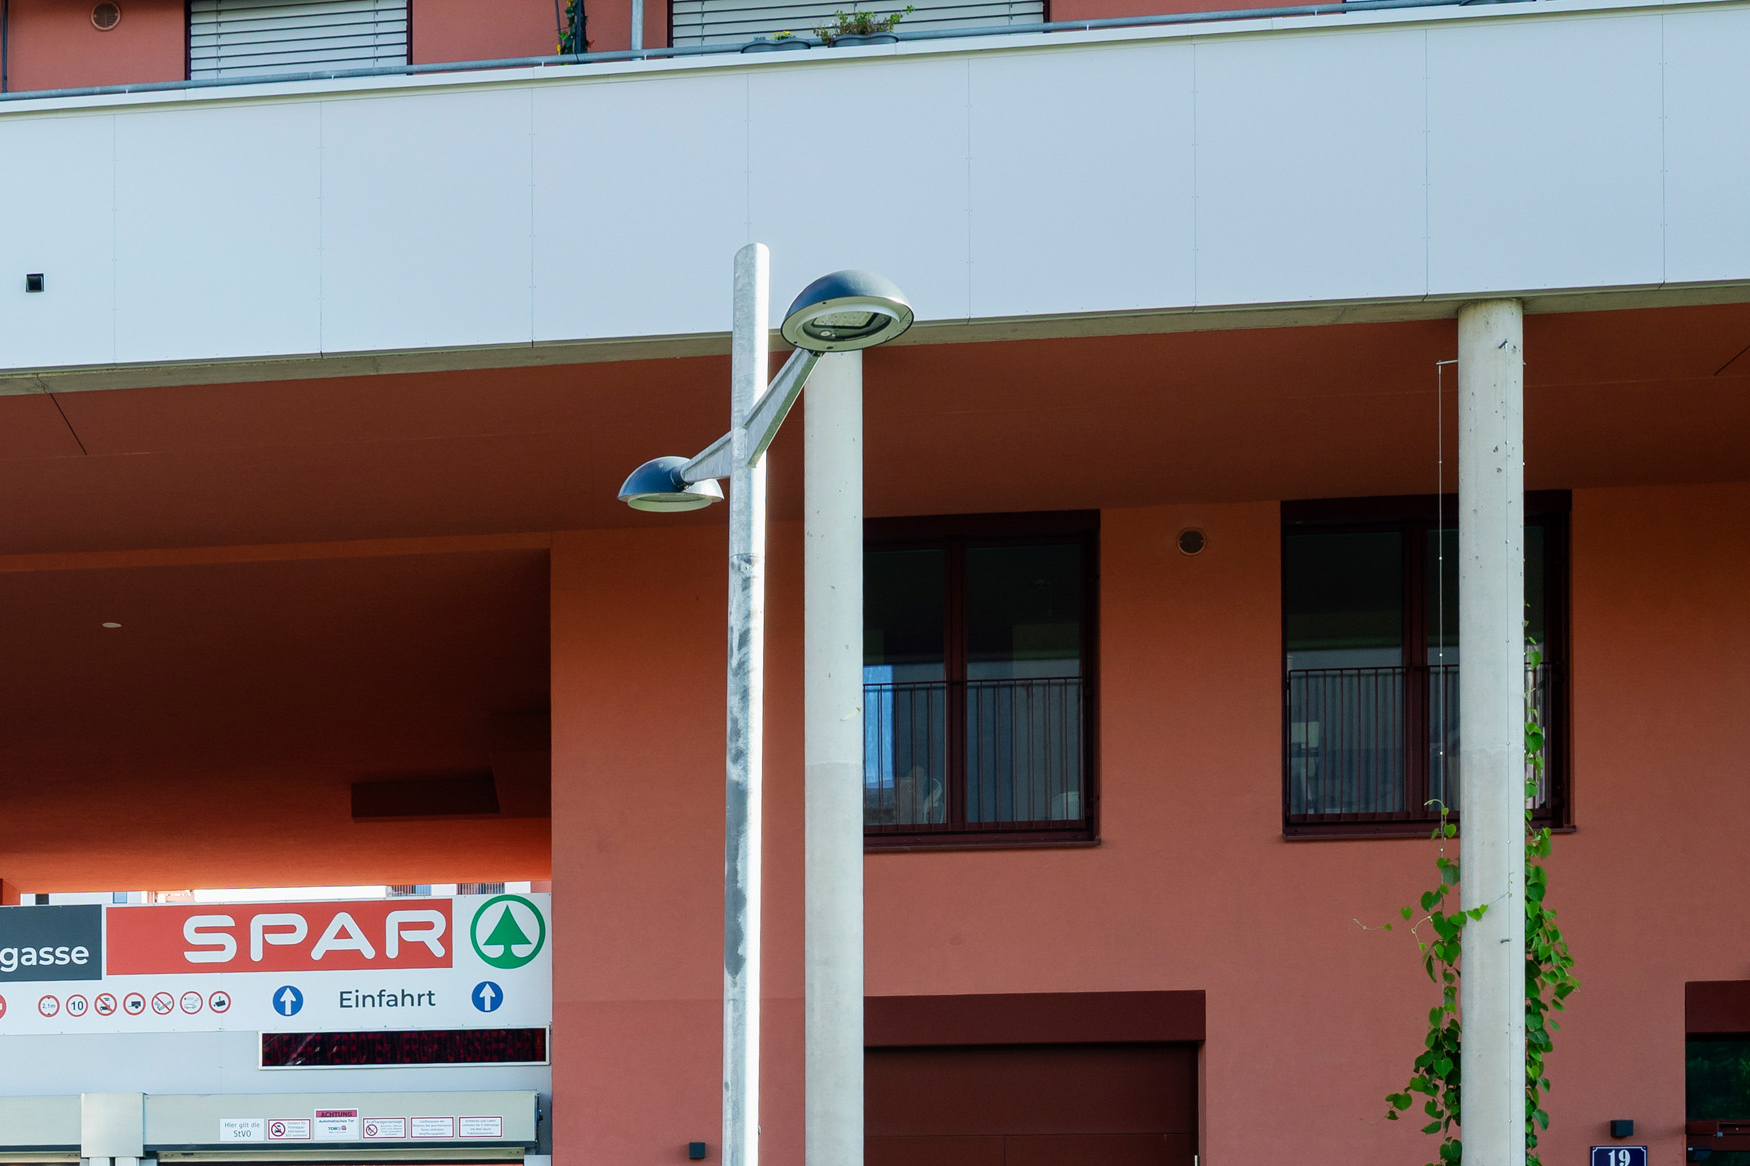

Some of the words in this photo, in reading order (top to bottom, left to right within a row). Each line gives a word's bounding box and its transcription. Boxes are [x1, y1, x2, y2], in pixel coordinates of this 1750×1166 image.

[183, 910, 447, 964] SPAR
[339, 989, 436, 1009] Einfahrt
[70, 1001, 84, 1011] 10
[238, 1122, 250, 1130] gilt
[233, 1130, 252, 1138] StVO
